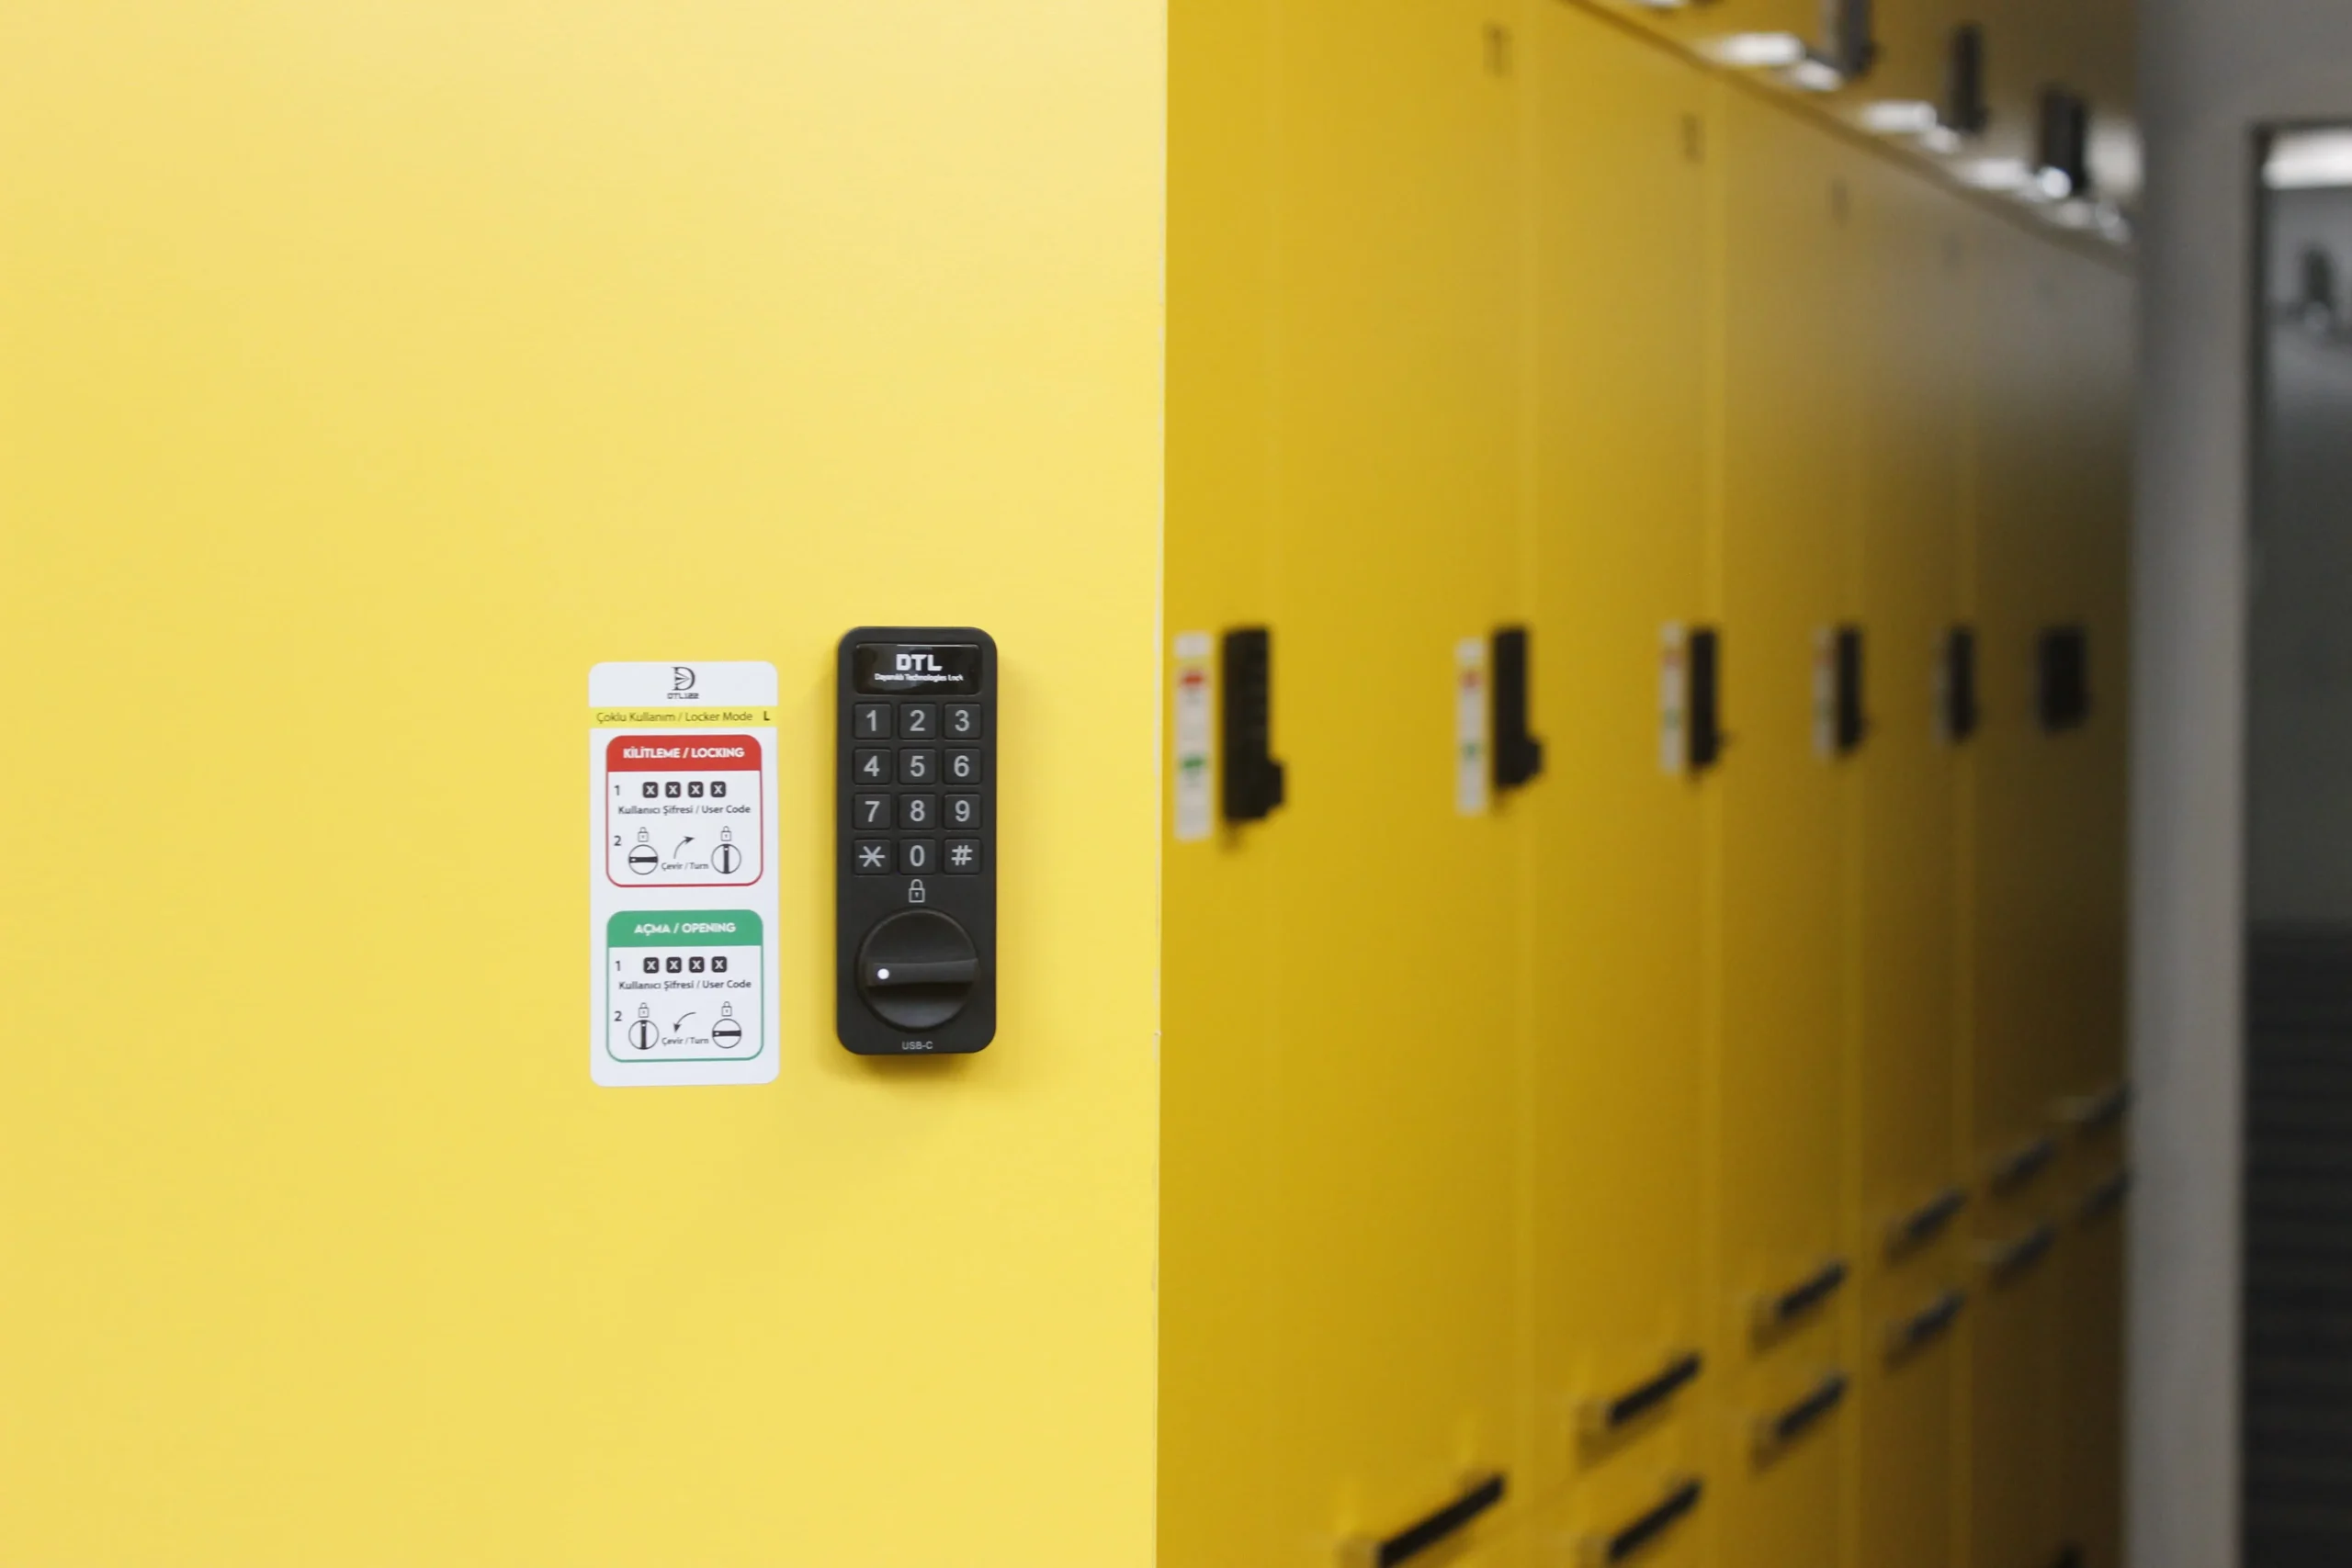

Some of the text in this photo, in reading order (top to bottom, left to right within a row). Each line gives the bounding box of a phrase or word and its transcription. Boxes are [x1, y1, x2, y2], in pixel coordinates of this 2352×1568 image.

[896, 653, 944, 671] DTL
[904, 673, 947, 682] Technologies
[597, 713, 627, 724] Çoklu
[629, 712, 676, 722] Kullanım
[685, 712, 720, 722] Locker
[722, 712, 753, 721] Mode
[763, 710, 771, 721] L
[866, 709, 970, 732] 1 2 3
[623, 746, 745, 759] KİLİTLEME / LOCKING
[863, 755, 970, 777] 4 5 6
[614, 784, 620, 796] 1
[618, 806, 661, 814] Kullanıcı
[663, 805, 694, 816] Şifresi
[701, 805, 724, 814] User
[726, 805, 752, 814] Code
[865, 800, 970, 822] 7 8 9
[614, 835, 622, 847] 2
[910, 845, 925, 867] 0
[951, 845, 973, 866] #
[662, 862, 684, 871] Çevir
[689, 862, 709, 870] Turn
[634, 922, 737, 936] AÇMA / OPENING
[615, 960, 621, 971] 1
[618, 981, 662, 990] Kullanıcı
[663, 980, 694, 991] Şifresi
[702, 980, 724, 989] User
[726, 980, 752, 988] Code
[614, 1010, 623, 1021] 2
[662, 1037, 684, 1046] Çevir
[690, 1036, 709, 1044] Turn
[901, 1041, 933, 1050] USB-C
